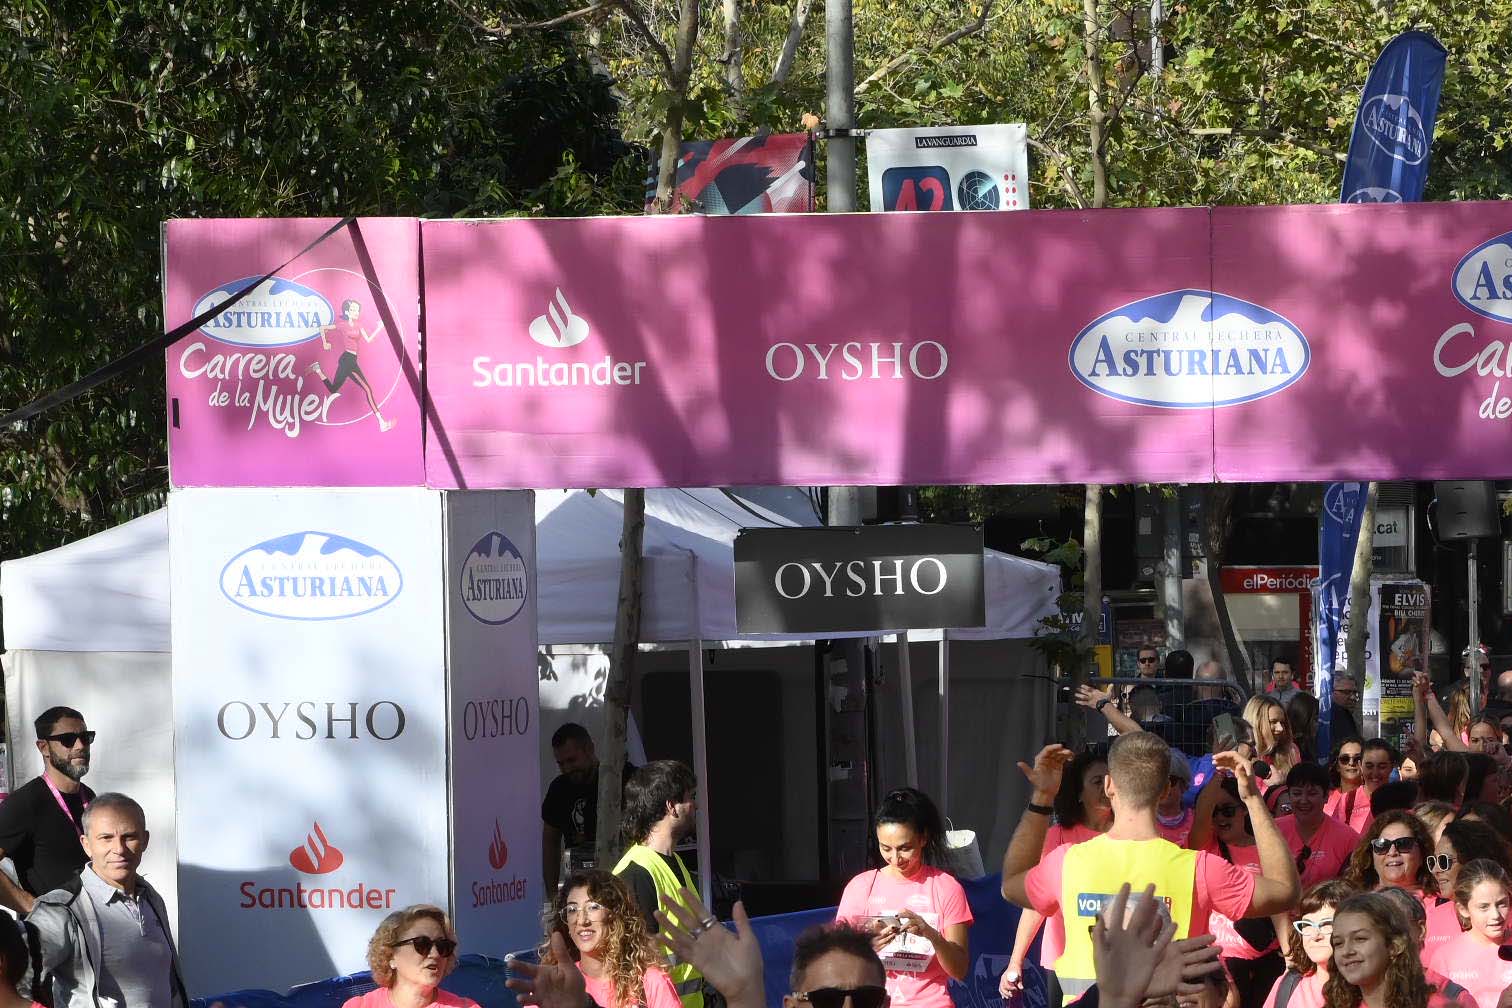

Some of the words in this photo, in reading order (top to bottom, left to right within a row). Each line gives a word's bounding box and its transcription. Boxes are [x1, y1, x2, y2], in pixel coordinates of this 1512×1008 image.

[203, 302, 323, 330] ASTURIANA
[1125, 330, 1198, 343] CENTRAL
[1208, 329, 1284, 342] LECHERA
[179, 343, 297, 381] Carrera
[471, 356, 647, 388] Santander
[765, 340, 949, 381] OYSHO
[1087, 334, 1292, 378] ASTURIANA
[208, 380, 232, 407] de
[234, 380, 251, 407] la
[248, 376, 341, 437] Mujer
[1374, 519, 1399, 535] .cat
[235, 564, 389, 599] ASTURIANA
[466, 566, 524, 602] ASTURIANA
[774, 558, 948, 600] OYSHO
[1394, 593, 1425, 606] ELVIS
[216, 700, 406, 741] OYSHO
[463, 696, 530, 741] OYSHO
[240, 881, 396, 910] Santander
[471, 877, 527, 908] Santander
